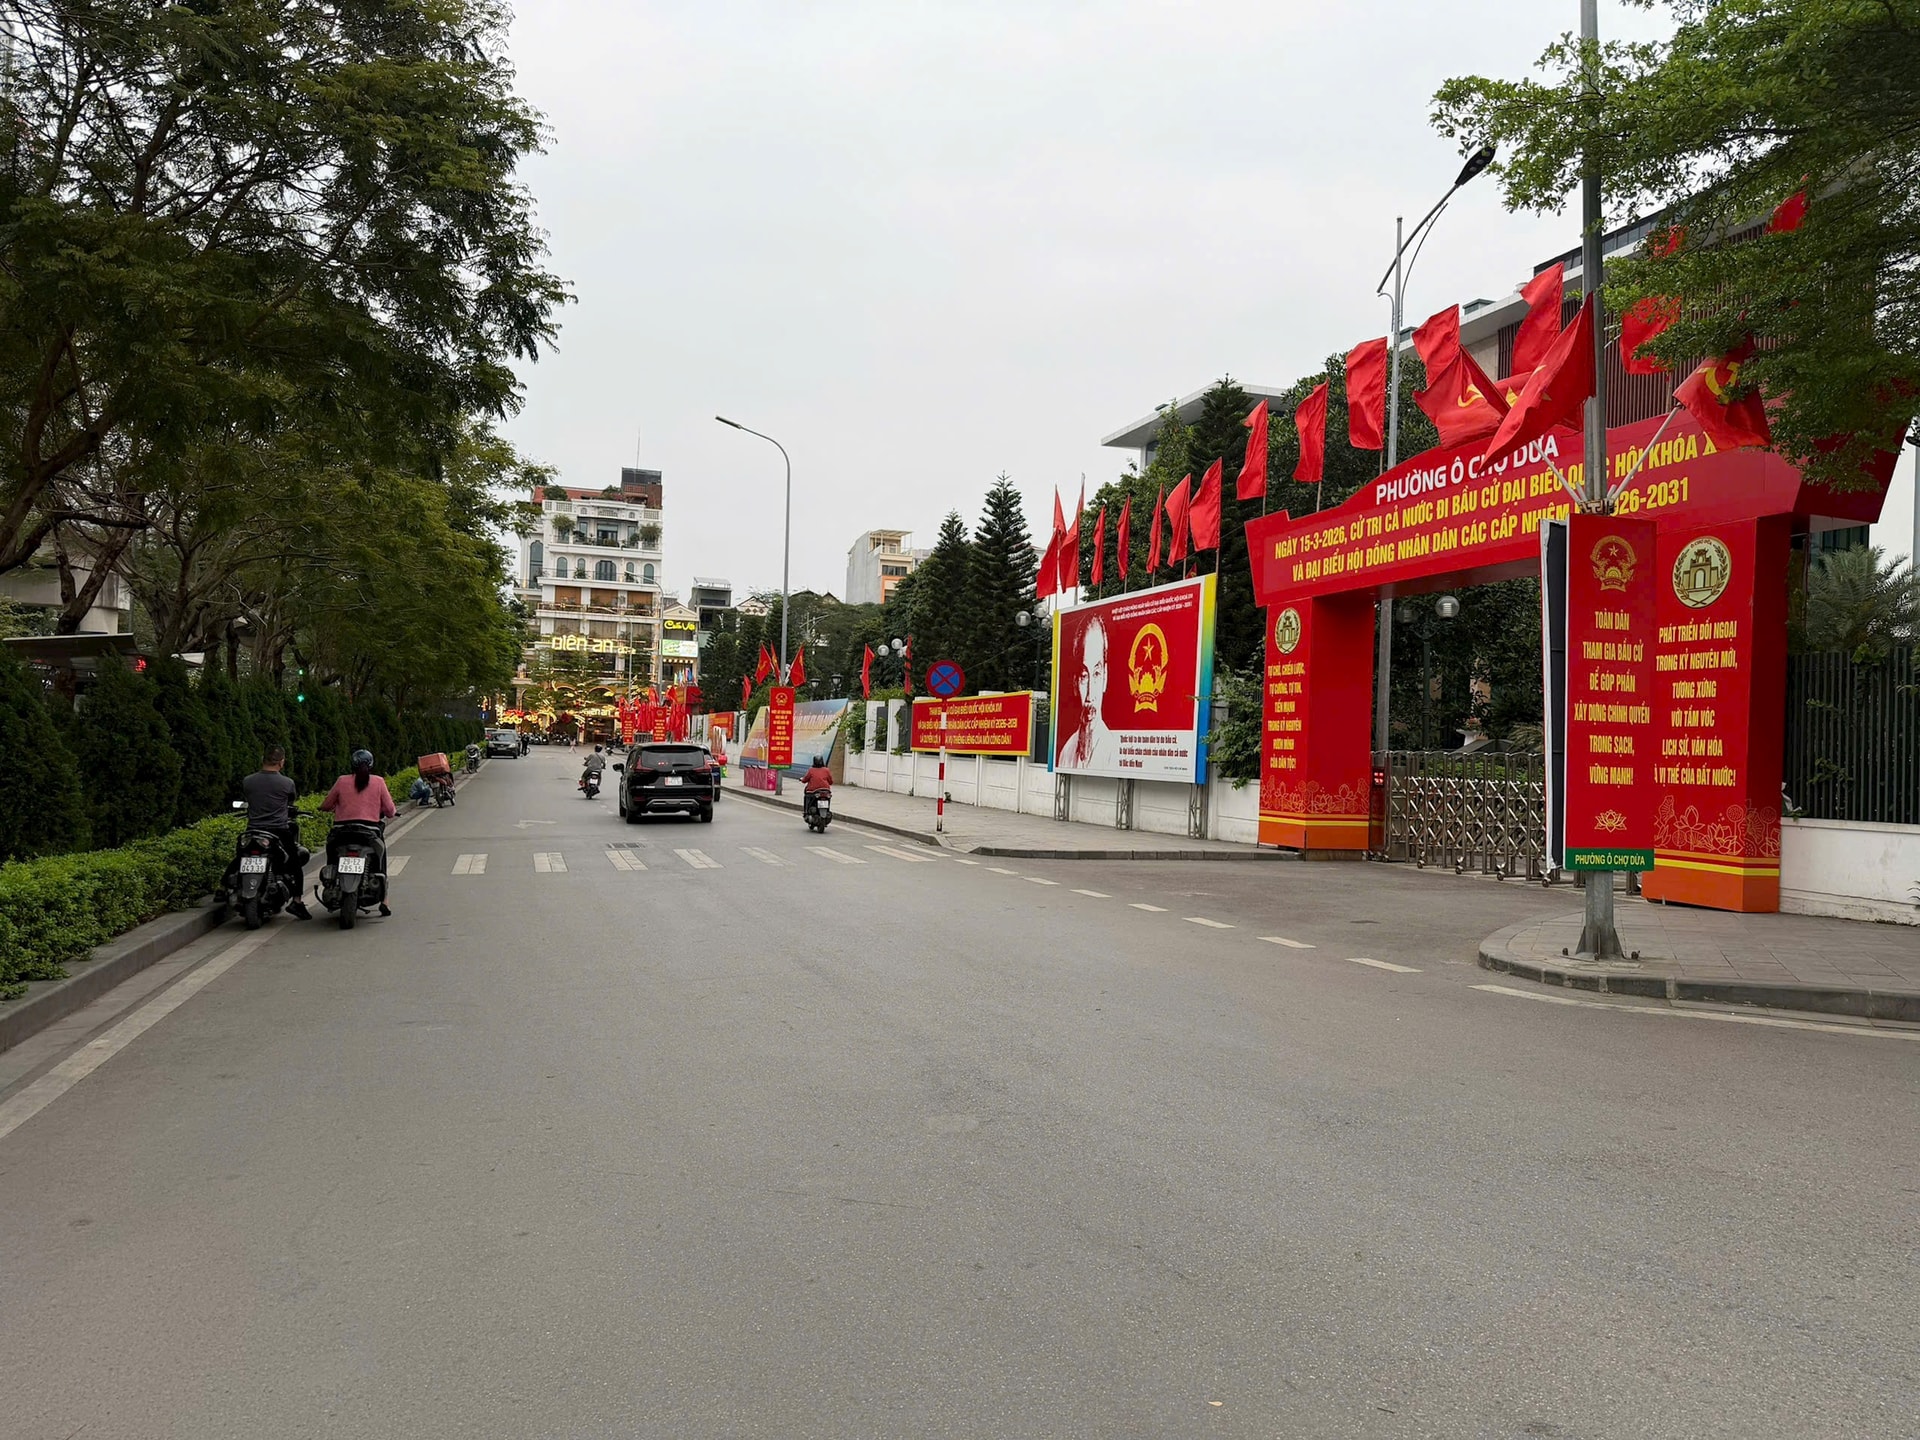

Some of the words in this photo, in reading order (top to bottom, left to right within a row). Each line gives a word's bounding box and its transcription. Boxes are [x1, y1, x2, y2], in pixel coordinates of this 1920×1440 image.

[1376, 465, 1446, 505] PHƯỜNG
[1450, 456, 1464, 484] Ô
[1275, 535, 1298, 560] NGÀY
[1300, 525, 1348, 553] 15-3-2026,
[1350, 514, 1364, 541] CỬ
[1366, 516, 1382, 536] TRI
[1385, 504, 1400, 533] CẢ
[1402, 500, 1433, 528] NƯỚC
[1436, 497, 1448, 519] ĐI
[1452, 485, 1477, 515] BẦU
[1481, 478, 1500, 508] CỬ
[1502, 478, 1526, 506] ĐẠI
[1530, 461, 1564, 498] BIỂU
[1615, 445, 1643, 480] HỘI
[1649, 432, 1698, 469] KHÓA
[1292, 560, 1304, 582] VÀ
[1306, 560, 1321, 582] ĐẠI
[1322, 548, 1344, 576] BIỂU
[1346, 547, 1364, 574] HỘI
[1366, 540, 1395, 567] ĐỒNG
[1398, 534, 1430, 561] NHÂN
[1432, 526, 1458, 553] DÂN
[1461, 520, 1487, 547] CÁC
[1490, 508, 1518, 541] CẤP
[1595, 608, 1613, 630] TOÀN
[1614, 609, 1630, 630] DÂN
[1659, 622, 1677, 644] PHÁT
[1678, 617, 1698, 642] TRIỂN
[1699, 616, 1712, 640] ĐỐI
[1714, 620, 1737, 643] NGOẠI
[1582, 641, 1602, 659] THAM
[1604, 642, 1616, 660] GIA
[1618, 638, 1632, 662] BẦU
[1633, 638, 1644, 662] CỬ
[1656, 654, 1678, 672] TRONG
[1679, 646, 1689, 671] KỶ
[1690, 650, 1719, 670] NGUYÊN
[1721, 648, 1738, 669] MỚI,
[1589, 666, 1600, 691] ĐỂ
[1600, 670, 1615, 691] GÓP
[1616, 668, 1636, 692] PHẦN
[1672, 681, 1695, 699] TƯƠNG
[1696, 677, 1717, 699] XỨNG
[1574, 699, 1587, 721] XÂY
[1588, 702, 1606, 725] DỰNG
[1607, 701, 1628, 723] CHÍNH
[1629, 700, 1650, 725] QUYỀN
[1671, 708, 1683, 727] VỚI
[1700, 708, 1715, 727] VÓC
[1589, 734, 1612, 754] TRONG
[1614, 736, 1635, 757] SẠCH,
[1662, 738, 1677, 758] LỊCH
[1678, 735, 1690, 758] SỬ,
[1691, 736, 1706, 756] VĂN
[1707, 735, 1723, 756] HÓA
[1589, 762, 1609, 785] VỮNG
[1610, 767, 1634, 788] MẠNH!
[1659, 768, 1666, 787] VỊ
[1667, 762, 1680, 785] THẾ
[1681, 766, 1695, 785] CỦA
[1697, 764, 1711, 786] ĐẤT
[1712, 765, 1736, 787] NƯỚC!
[1575, 852, 1605, 865] PHƯỜNG
[1607, 852, 1612, 864] Ô
[1613, 855, 1629, 867] CHỢ
[1630, 853, 1645, 865] DỪA
